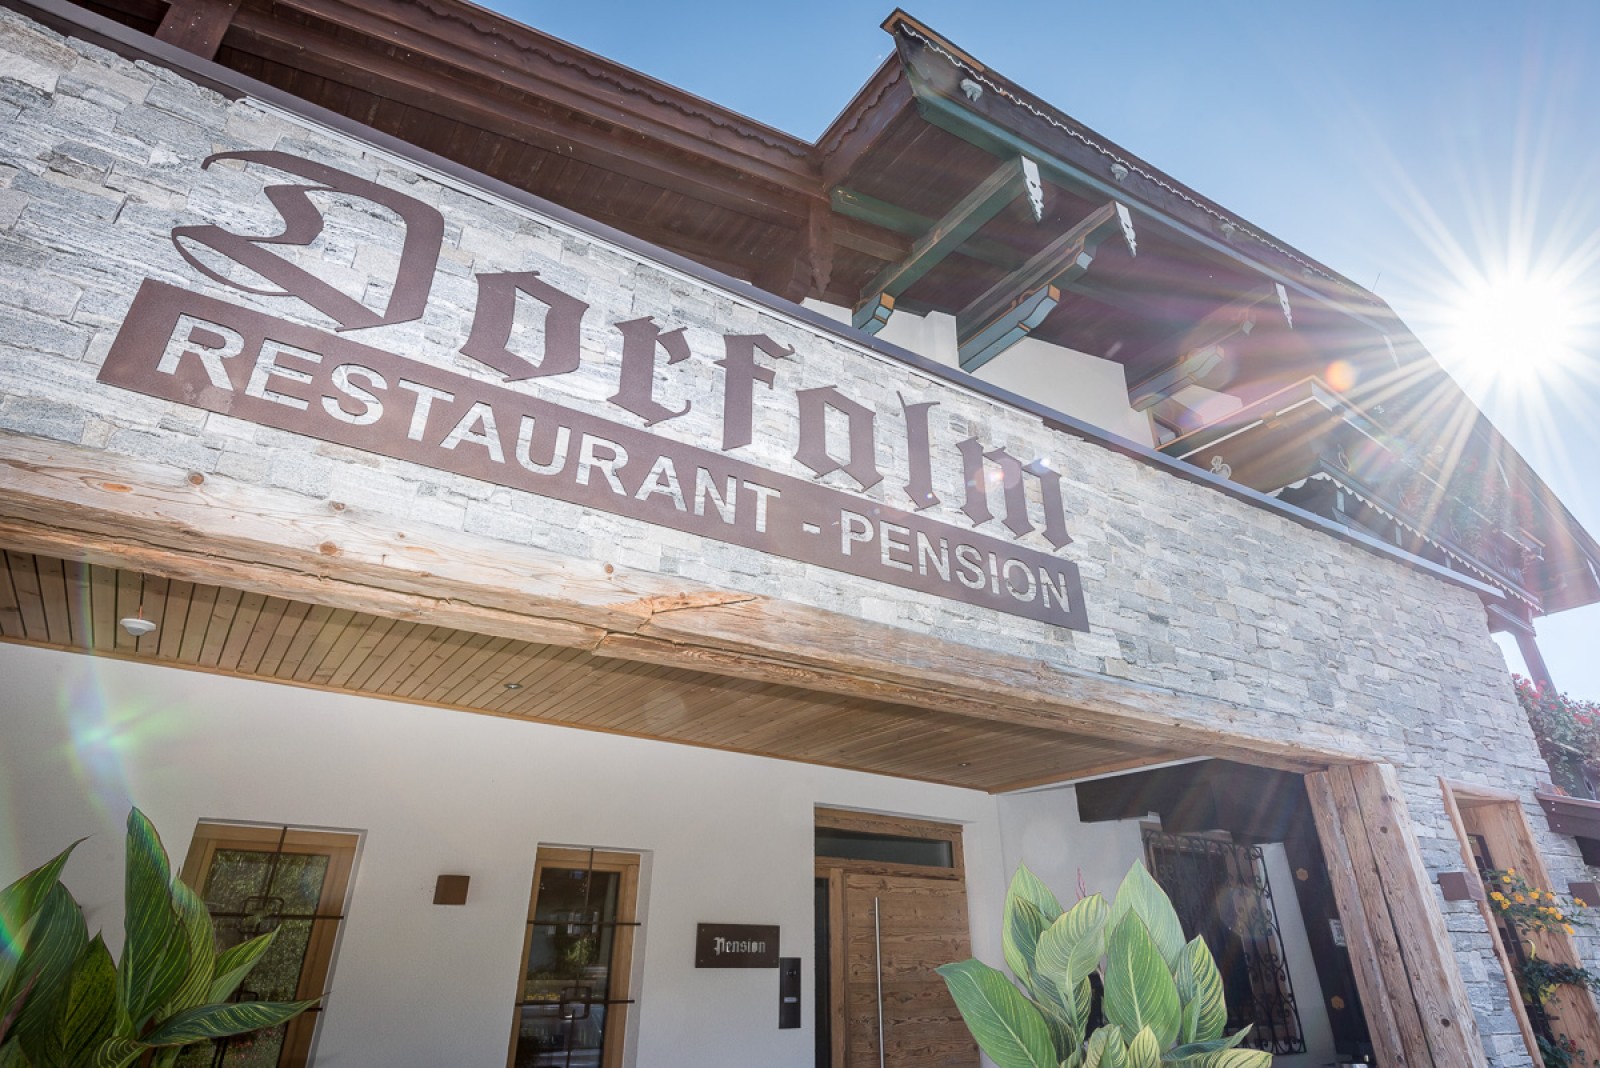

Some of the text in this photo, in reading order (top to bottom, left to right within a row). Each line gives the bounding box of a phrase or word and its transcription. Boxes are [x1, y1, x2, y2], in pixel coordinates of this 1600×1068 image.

[156, 312, 782, 534] RESTAURANT
[840, 508, 1071, 613] PENSION
[171, 150, 1073, 551] Dorfalm
[714, 937, 766, 956] Pension
